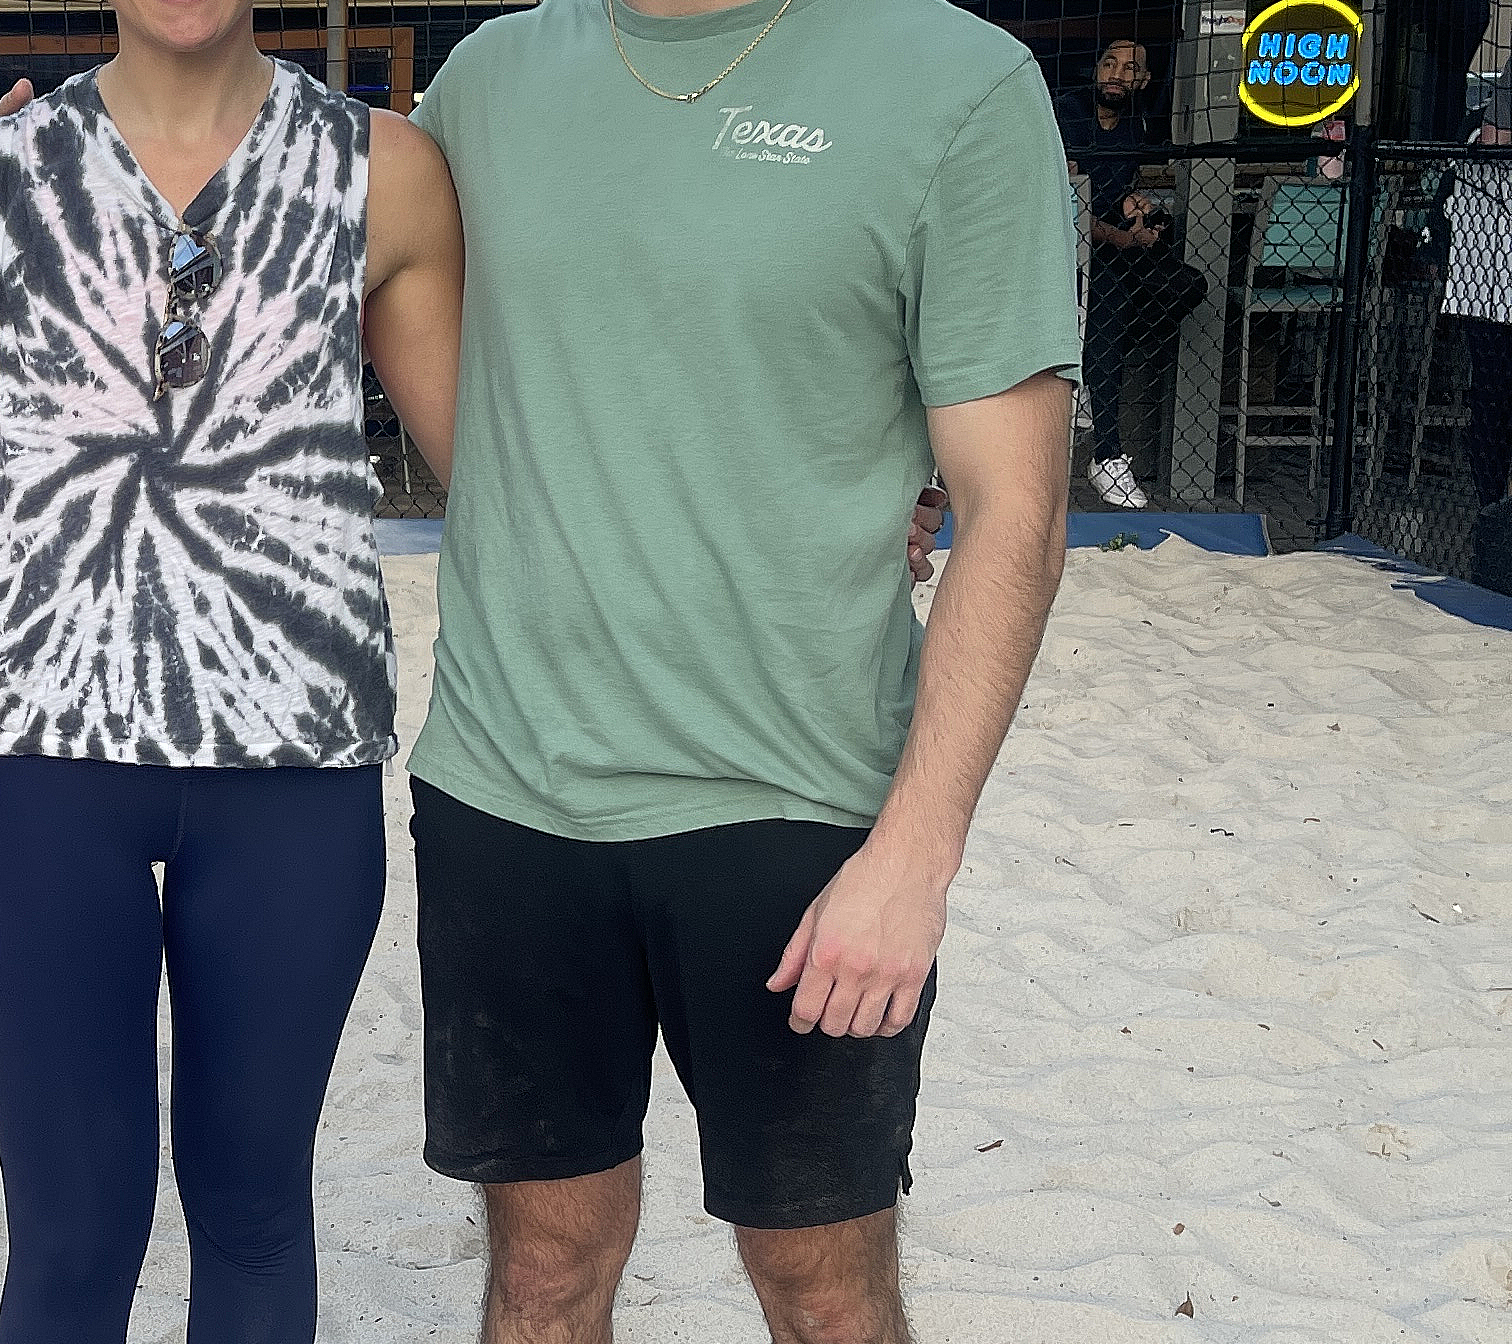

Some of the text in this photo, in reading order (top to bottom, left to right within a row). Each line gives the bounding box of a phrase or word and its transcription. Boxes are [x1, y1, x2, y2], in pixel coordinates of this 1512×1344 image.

[1258, 32, 1350, 60] HIGH
[1247, 60, 1352, 86] NOON
[712, 105, 833, 153] Texas
